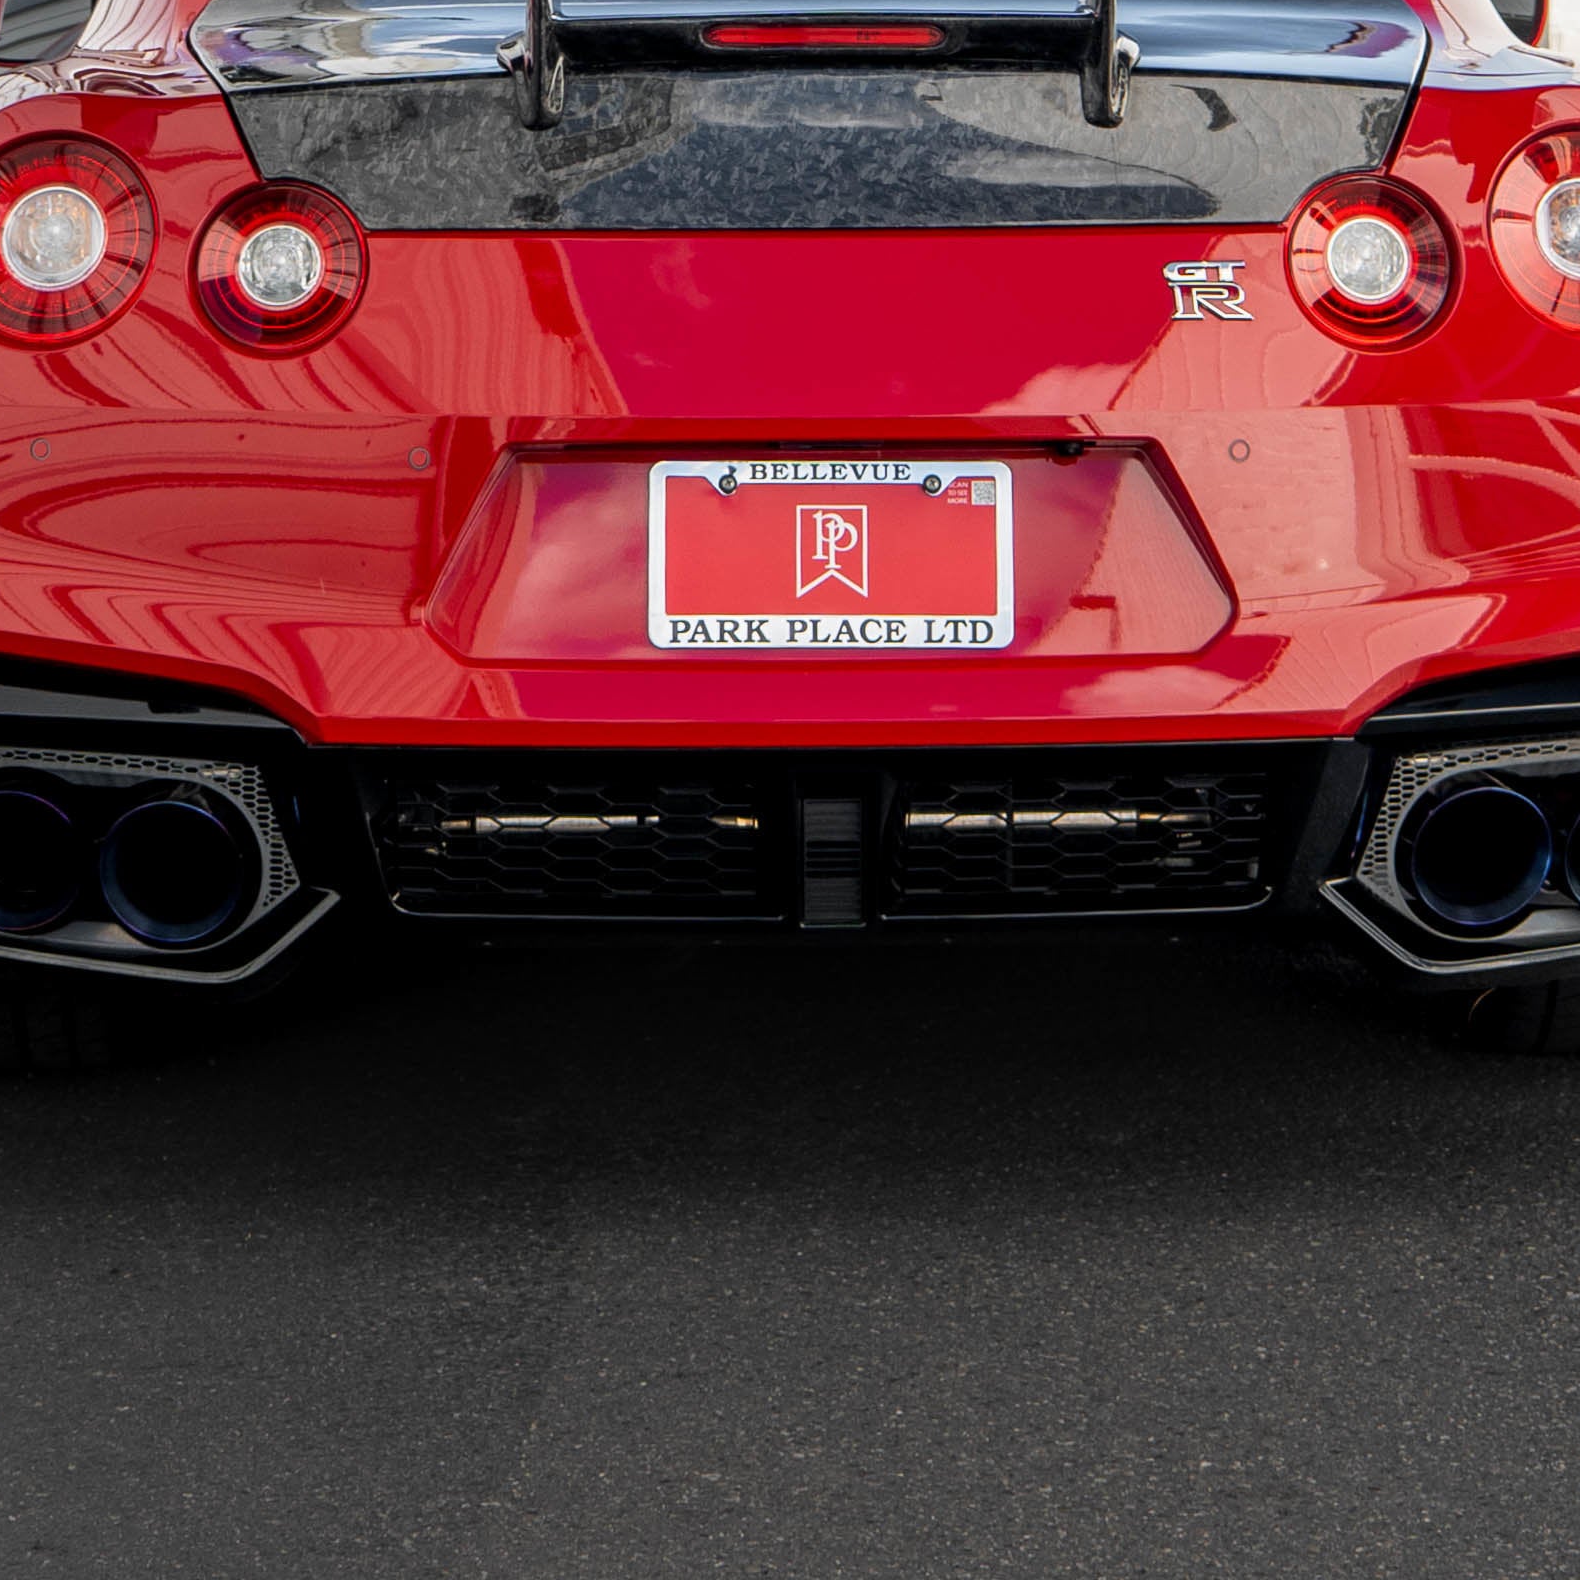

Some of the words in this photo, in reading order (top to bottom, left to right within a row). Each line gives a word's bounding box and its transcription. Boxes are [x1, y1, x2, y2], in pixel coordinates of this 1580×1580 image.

[749, 463, 911, 480] BELLEVUE
[669, 619, 771, 644] PARK
[786, 619, 907, 644] PLACE
[924, 619, 994, 644] LTD
